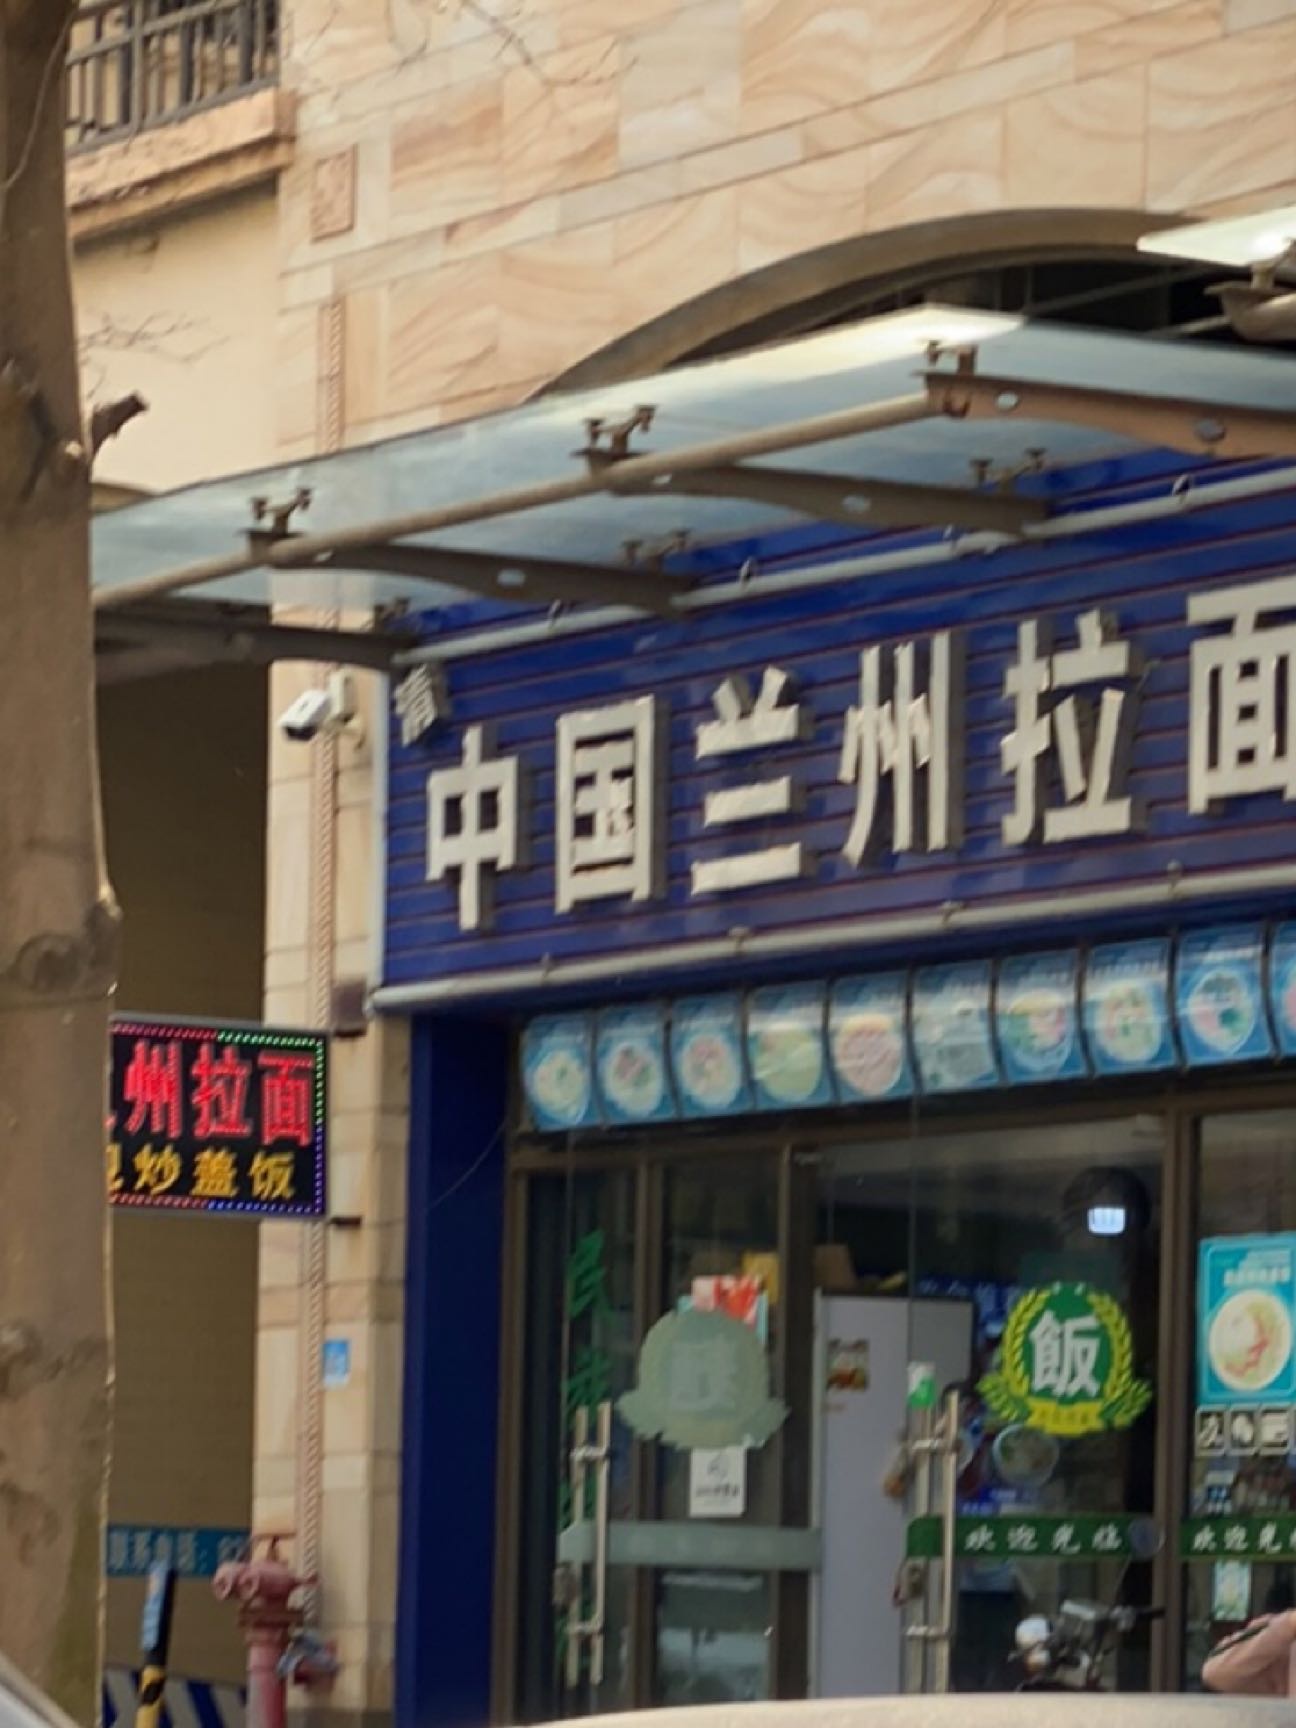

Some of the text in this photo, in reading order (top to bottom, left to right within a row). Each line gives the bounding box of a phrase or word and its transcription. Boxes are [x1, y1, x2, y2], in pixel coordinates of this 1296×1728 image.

[105, 1039, 315, 1147] 州拉面
[1029, 1309, 1101, 1398] 飯
[965, 1524, 1123, 1554] 欢迎光临
